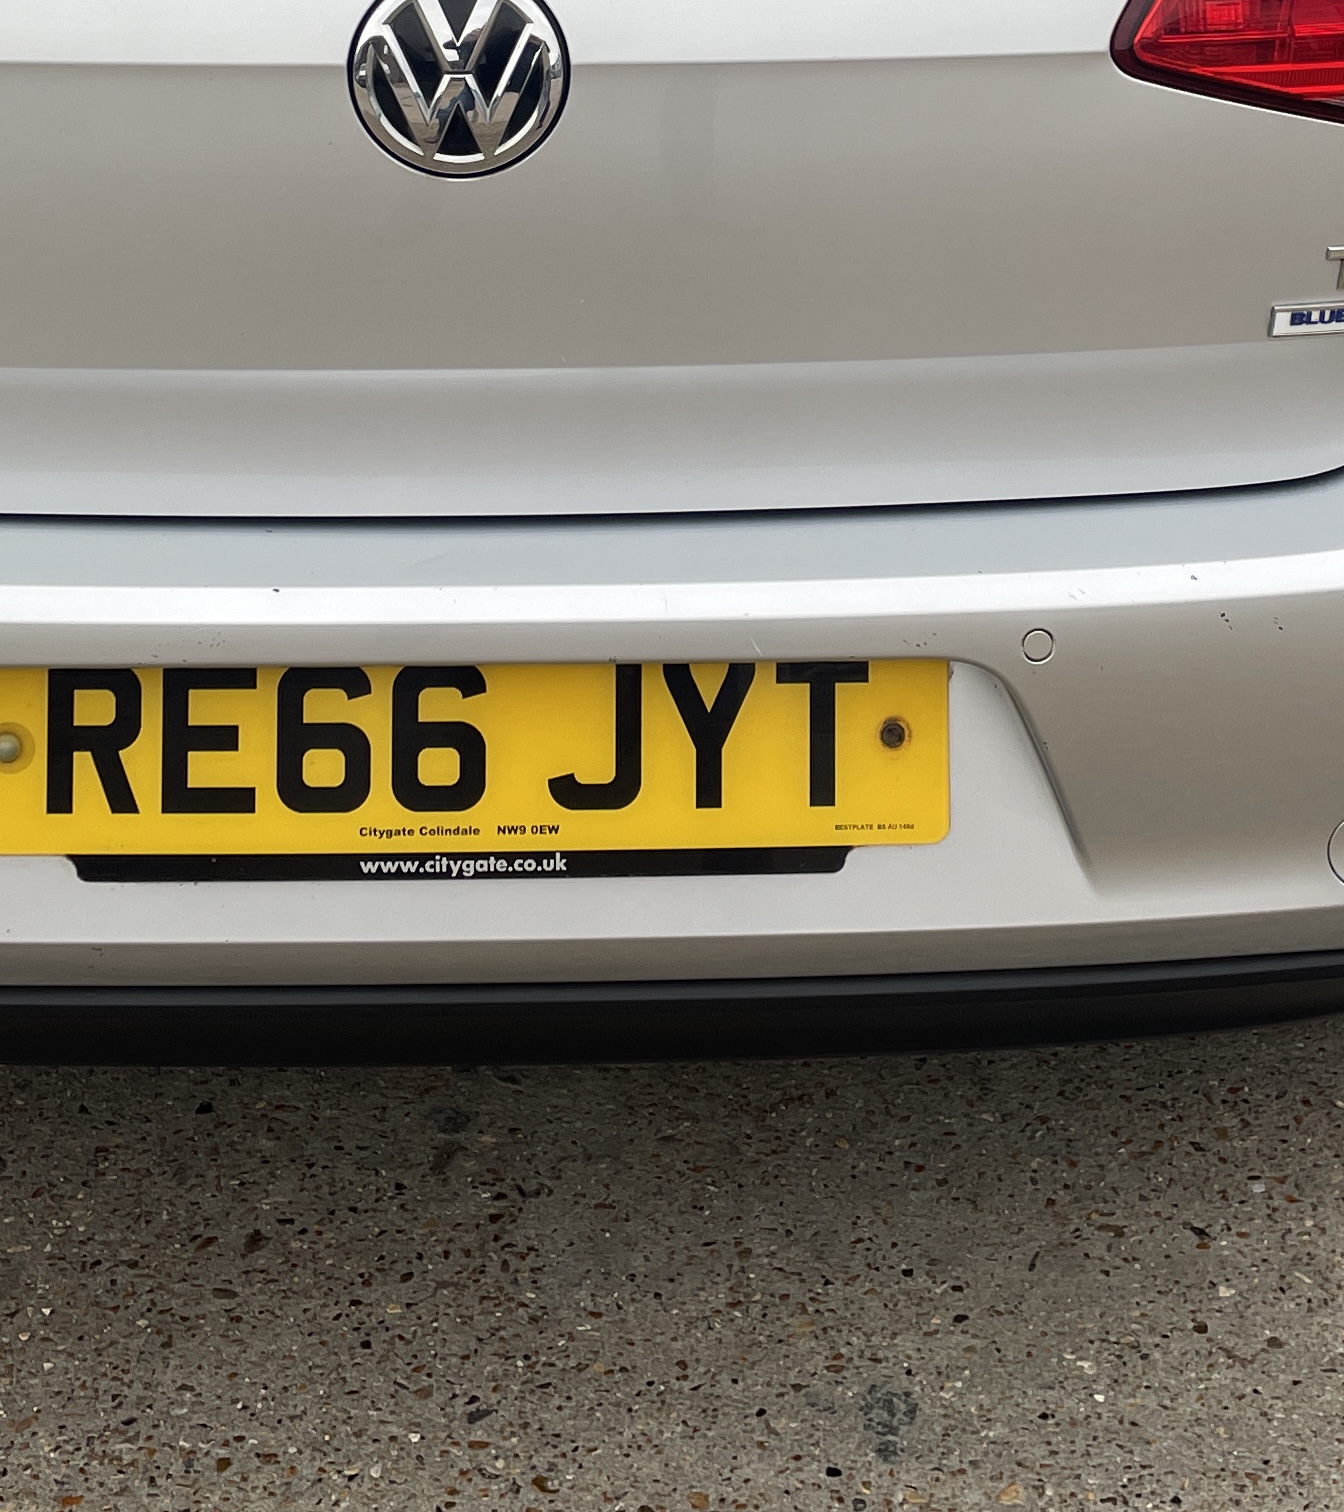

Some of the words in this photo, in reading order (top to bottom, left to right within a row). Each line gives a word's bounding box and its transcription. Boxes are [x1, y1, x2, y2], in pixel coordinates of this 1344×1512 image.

[46, 665, 488, 815] RE66
[547, 660, 870, 811] JYT
[359, 826, 415, 839] Citygate
[419, 825, 481, 836] Colindale
[497, 824, 527, 835] NW9
[359, 852, 568, 877] www.citygate.co.uk
